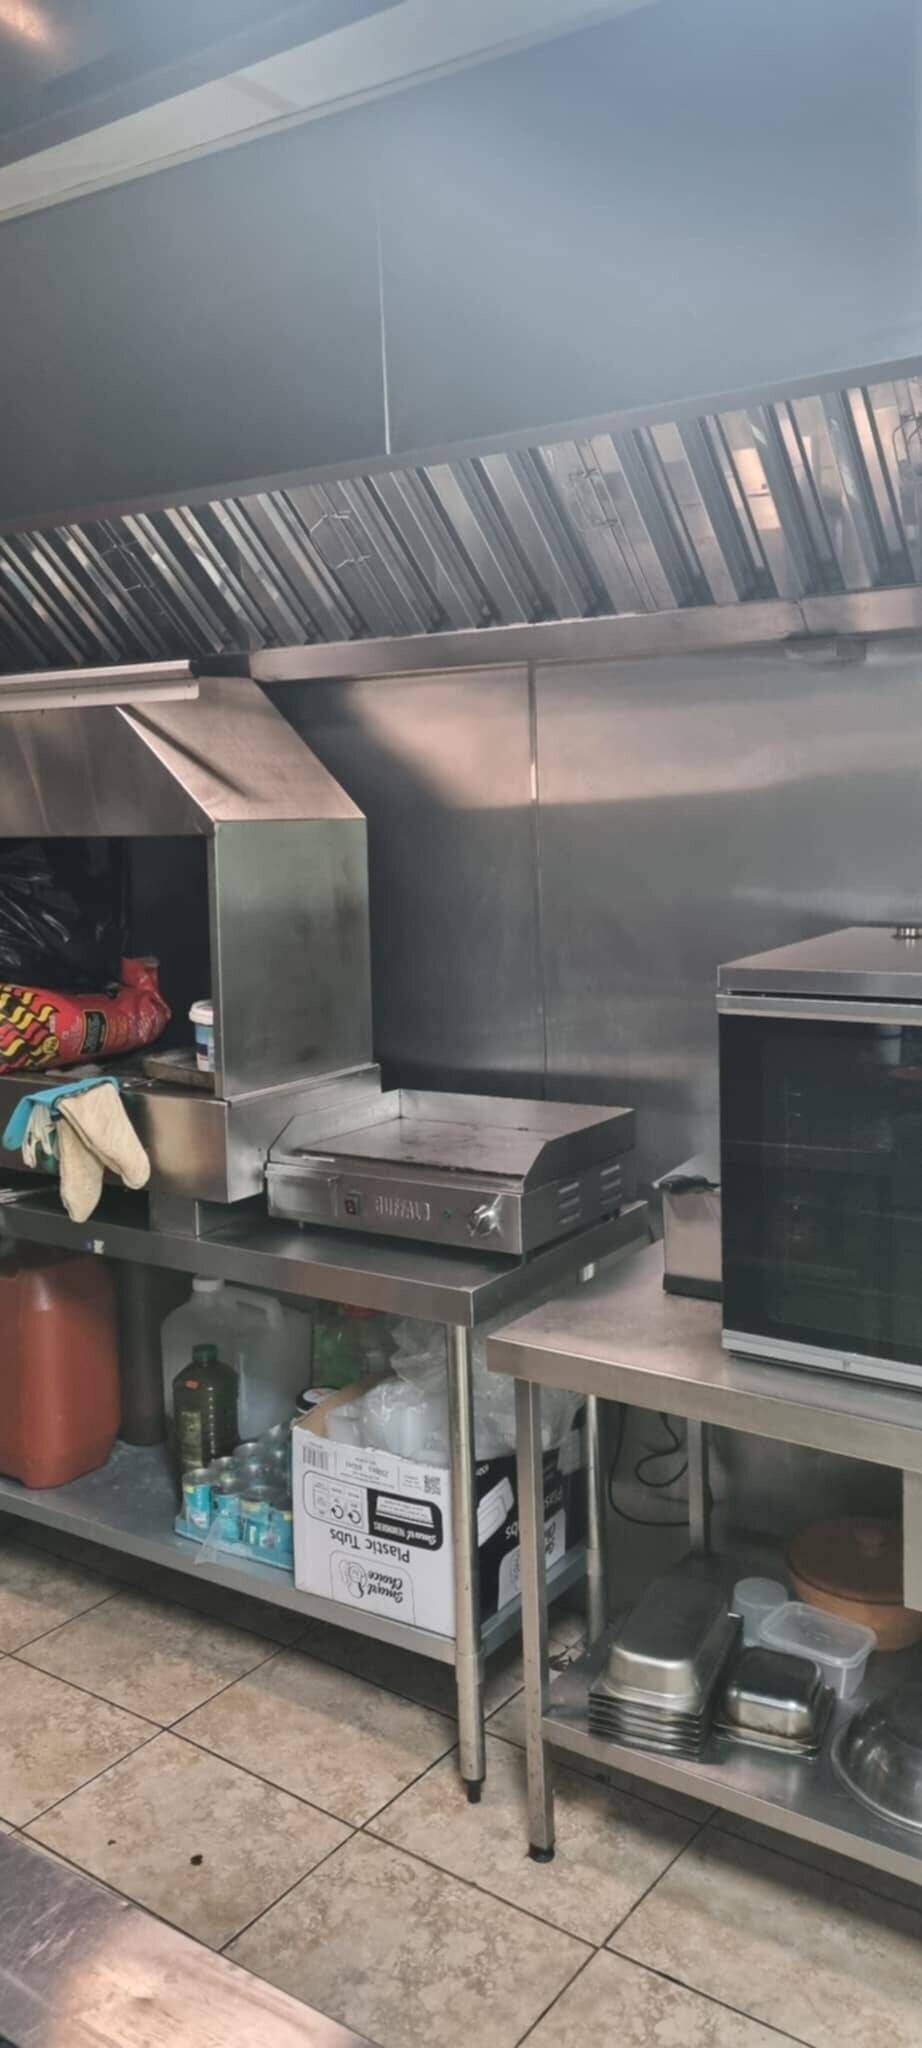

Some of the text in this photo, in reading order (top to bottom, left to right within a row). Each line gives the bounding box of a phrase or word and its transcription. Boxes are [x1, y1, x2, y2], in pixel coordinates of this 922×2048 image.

[330, 1528, 410, 1563] Plastic Tubs
[406, 1530, 437, 1546] Smart
[367, 1569, 403, 1590] Choice
[367, 1582, 403, 1604] Smart
